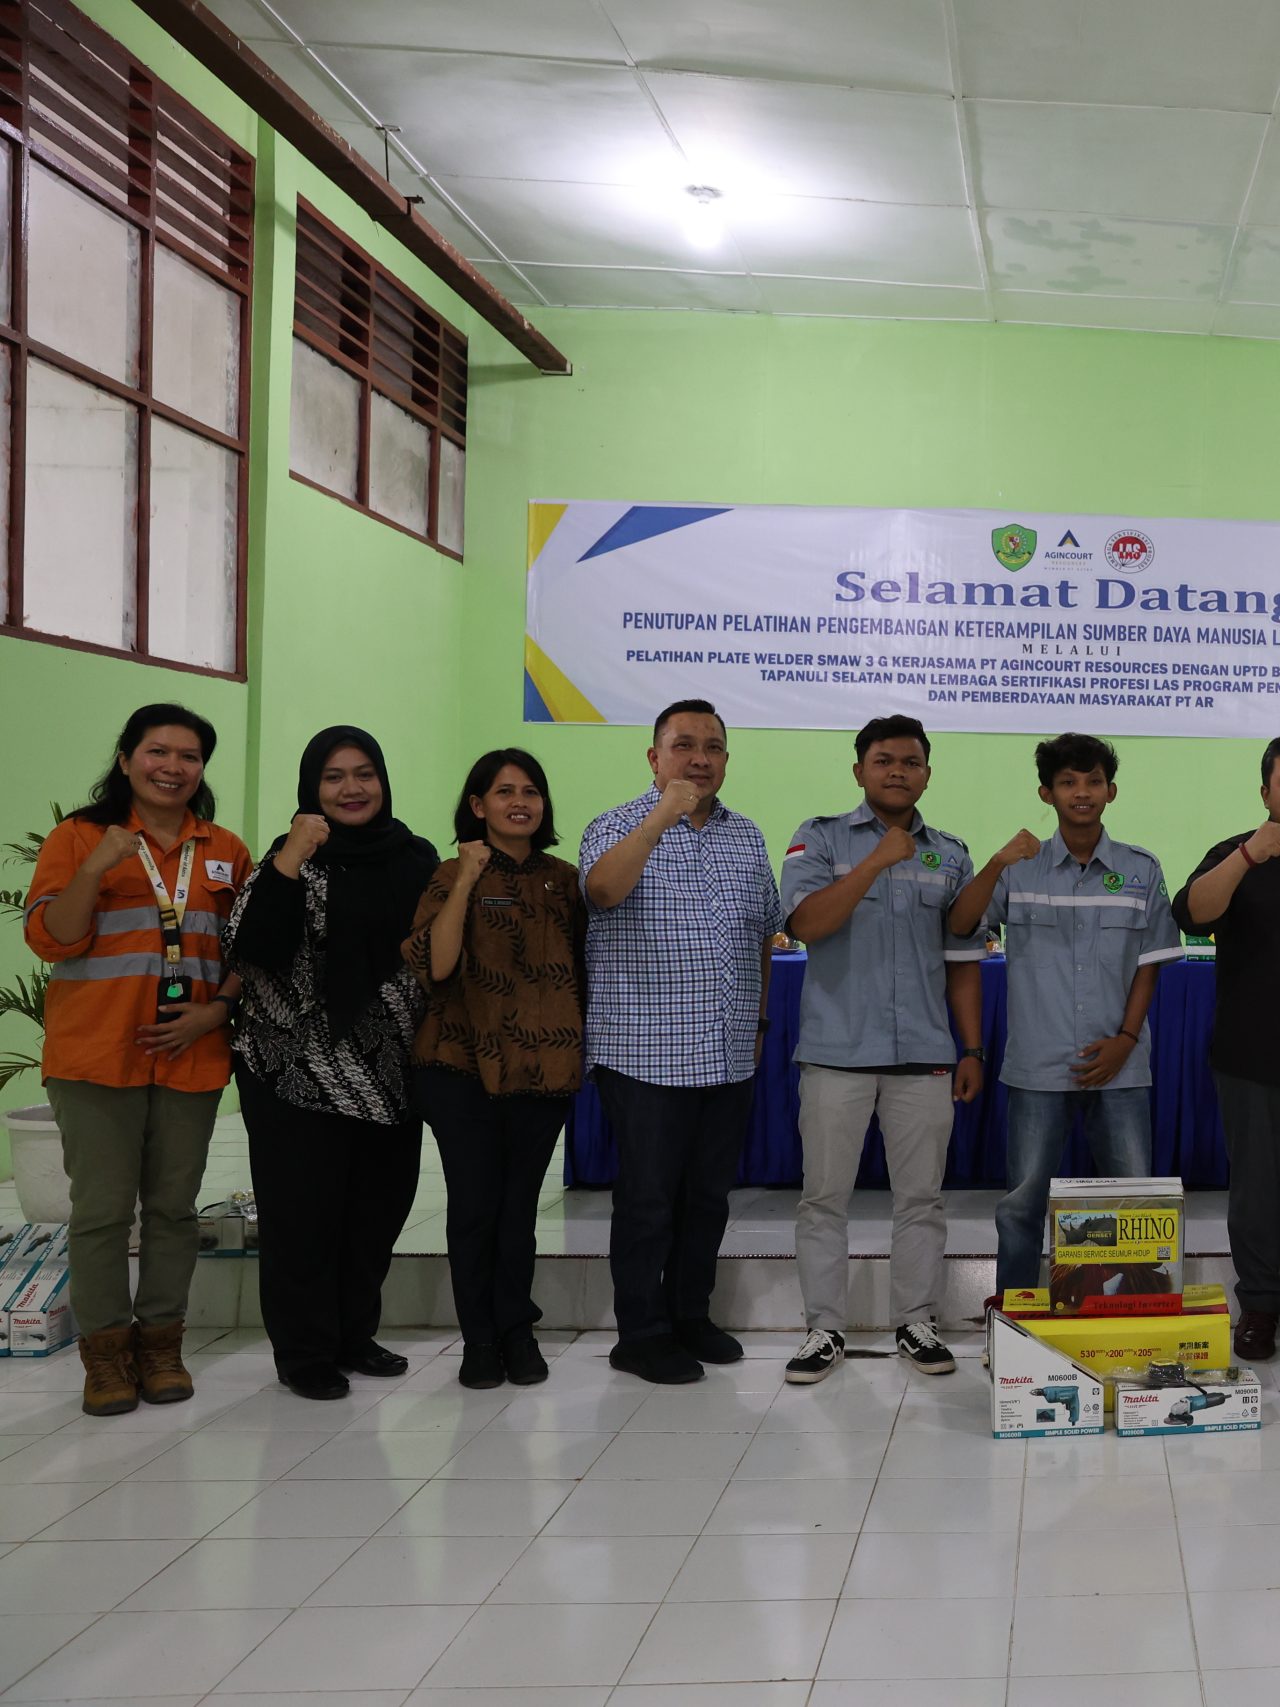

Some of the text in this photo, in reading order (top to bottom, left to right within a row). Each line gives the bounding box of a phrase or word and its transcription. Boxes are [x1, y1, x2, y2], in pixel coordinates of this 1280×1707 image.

[1044, 551, 1093, 560] AGINCOURT
[1119, 544, 1140, 552] LAS
[834, 571, 1078, 608] Selamat
[622, 612, 717, 631] PENUTUPAN
[723, 614, 810, 633] PELATIHAN
[816, 616, 948, 637] PENGEMBANGAN
[954, 620, 1077, 640] KETERAMPILAN
[1083, 624, 1147, 642] SUMBER
[1153, 626, 1191, 643] DAYA
[1196, 627, 1266, 646] MANUSIA
[1022, 644, 1122, 656] MELALUI
[626, 650, 704, 663] PELATIHAN
[708, 652, 750, 664] PLATE
[754, 653, 813, 666] WELDER
[817, 654, 862, 667] SMAW
[865, 656, 874, 667] 3
[878, 656, 888, 668] G
[892, 656, 976, 670] KERJASAMA
[980, 658, 997, 670] PT
[1000, 659, 1082, 672] AGINCOURT
[1085, 661, 1168, 674] RESOURCES
[1172, 663, 1229, 676] DENGAN
[1233, 665, 1268, 677] UPTD
[760, 669, 828, 682] TAPANULI
[832, 671, 893, 684] SELATAN
[897, 673, 926, 685] DAN
[930, 674, 997, 686] LEMBAGA
[1001, 675, 1086, 688] SERTIFIKASI
[1090, 677, 1149, 690] PROFESI
[1154, 679, 1180, 691] LAS
[1183, 680, 1253, 693] PROGRAM
[928, 690, 1214, 708] DAN PEMBERDAYAAN MASYARAKAT PT AR
[1118, 1218, 1174, 1240] RHINO
[1058, 1249, 1150, 1258] GARANSI SERVICE SEUMUR HIDUP
[16, 1283, 39, 1309] makita
[1094, 1302, 1136, 1310] Teknologi
[998, 1376, 1034, 1385] makita
[1122, 1394, 1159, 1404] makita
